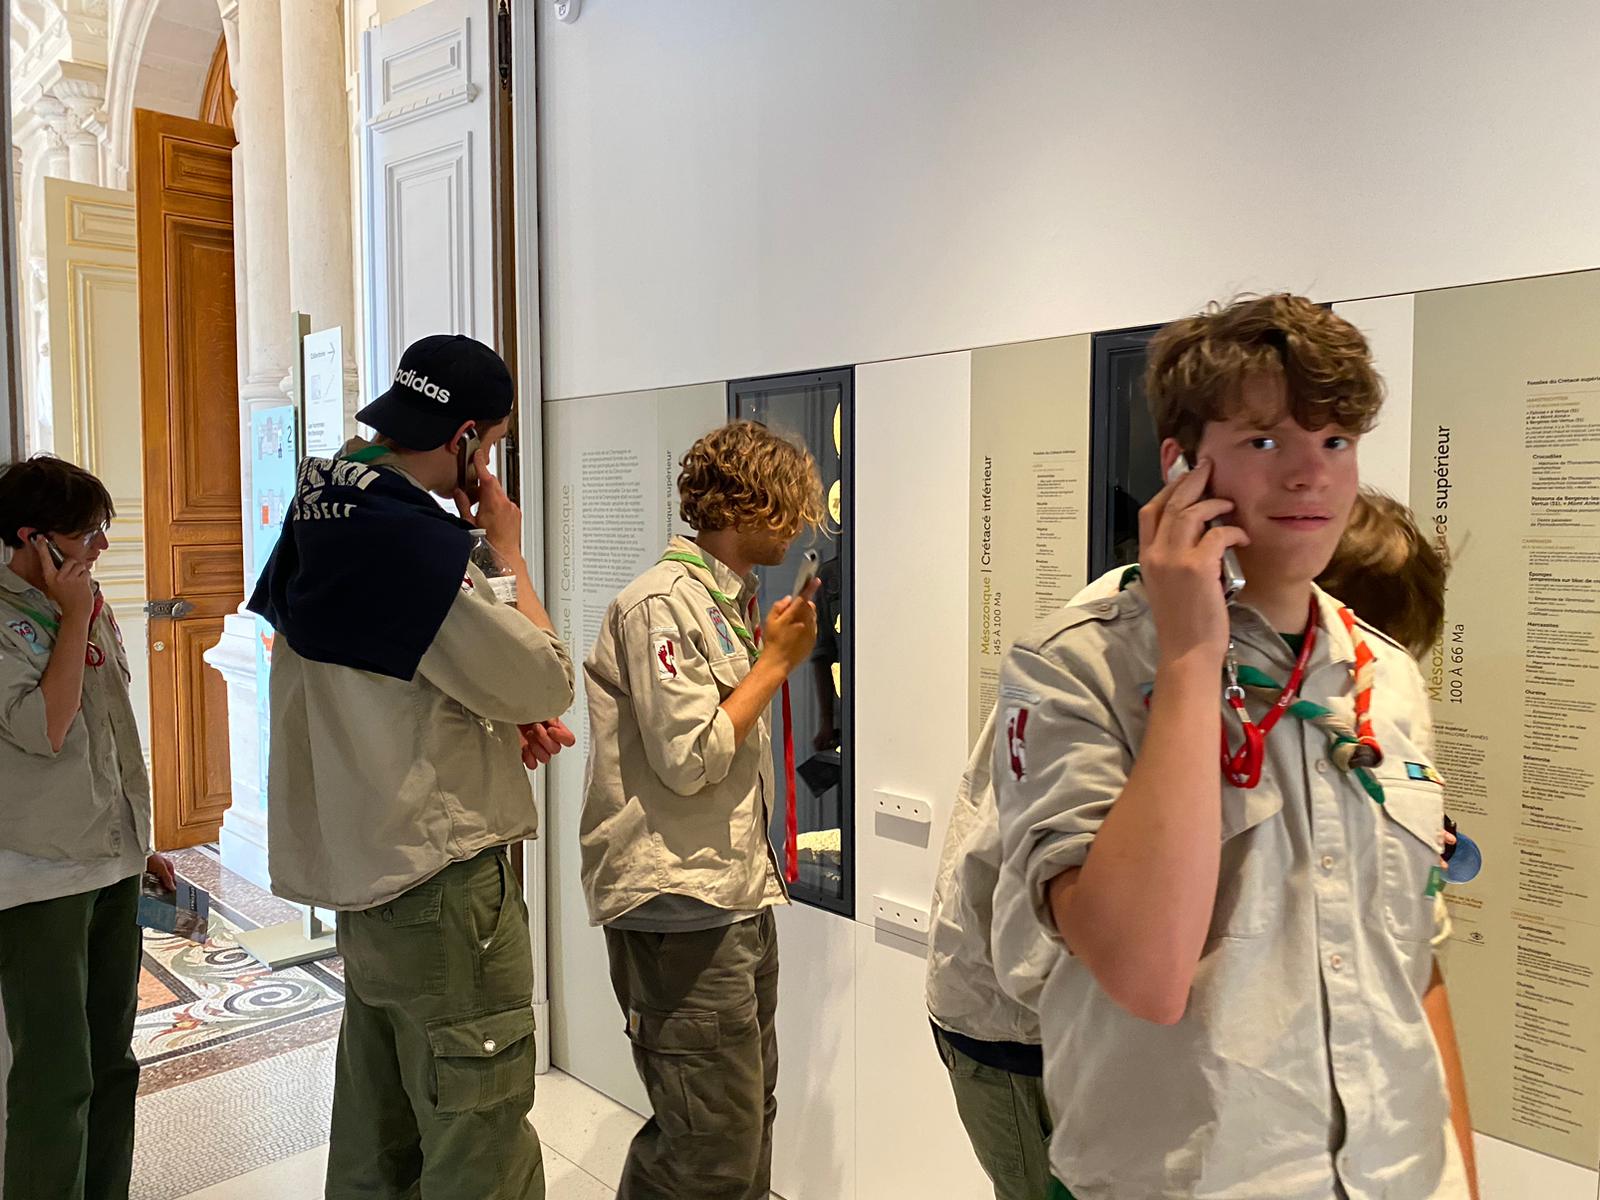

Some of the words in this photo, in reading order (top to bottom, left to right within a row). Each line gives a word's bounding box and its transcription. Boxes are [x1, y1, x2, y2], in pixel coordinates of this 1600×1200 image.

[395, 369, 450, 403] adidas
[287, 425, 293, 443] 2
[982, 456, 992, 511] inférieur
[1434, 425, 1452, 509] supérieur
[561, 485, 572, 592] Cénozoïque
[981, 515, 991, 565] Crétacé
[981, 577, 992, 655] Mésozoïque
[994, 592, 1001, 606] Ma
[1452, 624, 1465, 643] Ma
[1451, 647, 1464, 663] 66
[1450, 679, 1463, 703] 100
